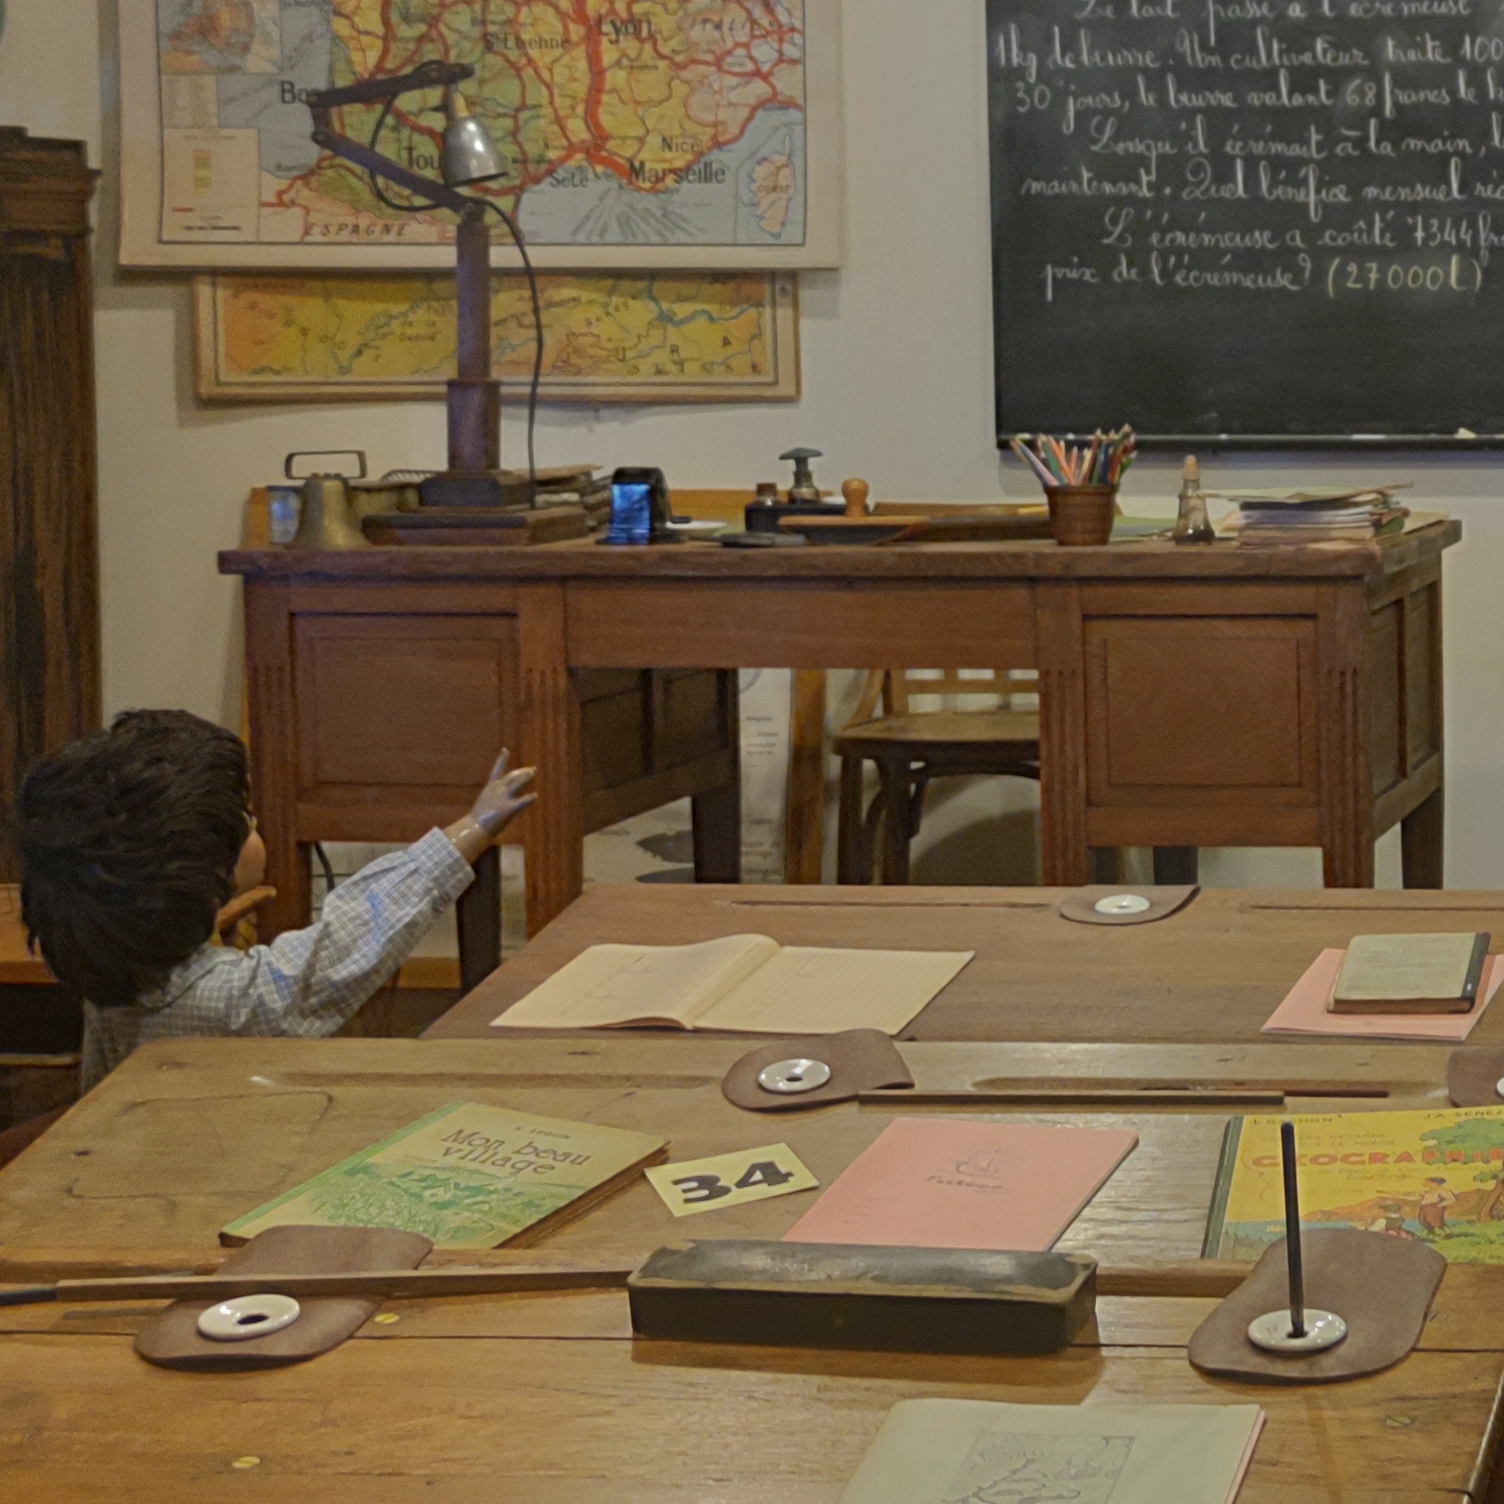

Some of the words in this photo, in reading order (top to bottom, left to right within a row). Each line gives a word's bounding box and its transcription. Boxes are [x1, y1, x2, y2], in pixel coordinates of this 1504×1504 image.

[1046, 24, 1078, 70] de
[1229, 23, 1372, 70] cultivateur
[1382, 32, 1453, 64] traite
[1015, 79, 1051, 114] 30
[1137, 72, 1158, 107] le
[1167, 71, 1240, 108] beurre
[1246, 67, 1334, 107] valant
[1344, 78, 1377, 106] 68
[1382, 69, 1452, 119] francs
[1457, 68, 1478, 103] le
[1335, 126, 1362, 157] à
[1367, 116, 1396, 156] la
[627, 159, 726, 185] Marseille
[1182, 157, 1248, 200] Quel
[1361, 156, 1467, 201] mensuel
[1286, 227, 1307, 247] a
[1405, 214, 1472, 249] 7344
[1038, 258, 1099, 303] prix
[1110, 251, 1141, 284] de
[440, 1128, 506, 1151] Mon
[511, 1140, 592, 1166] beau
[441, 1146, 557, 1178] village
[670, 1160, 795, 1204] 34
